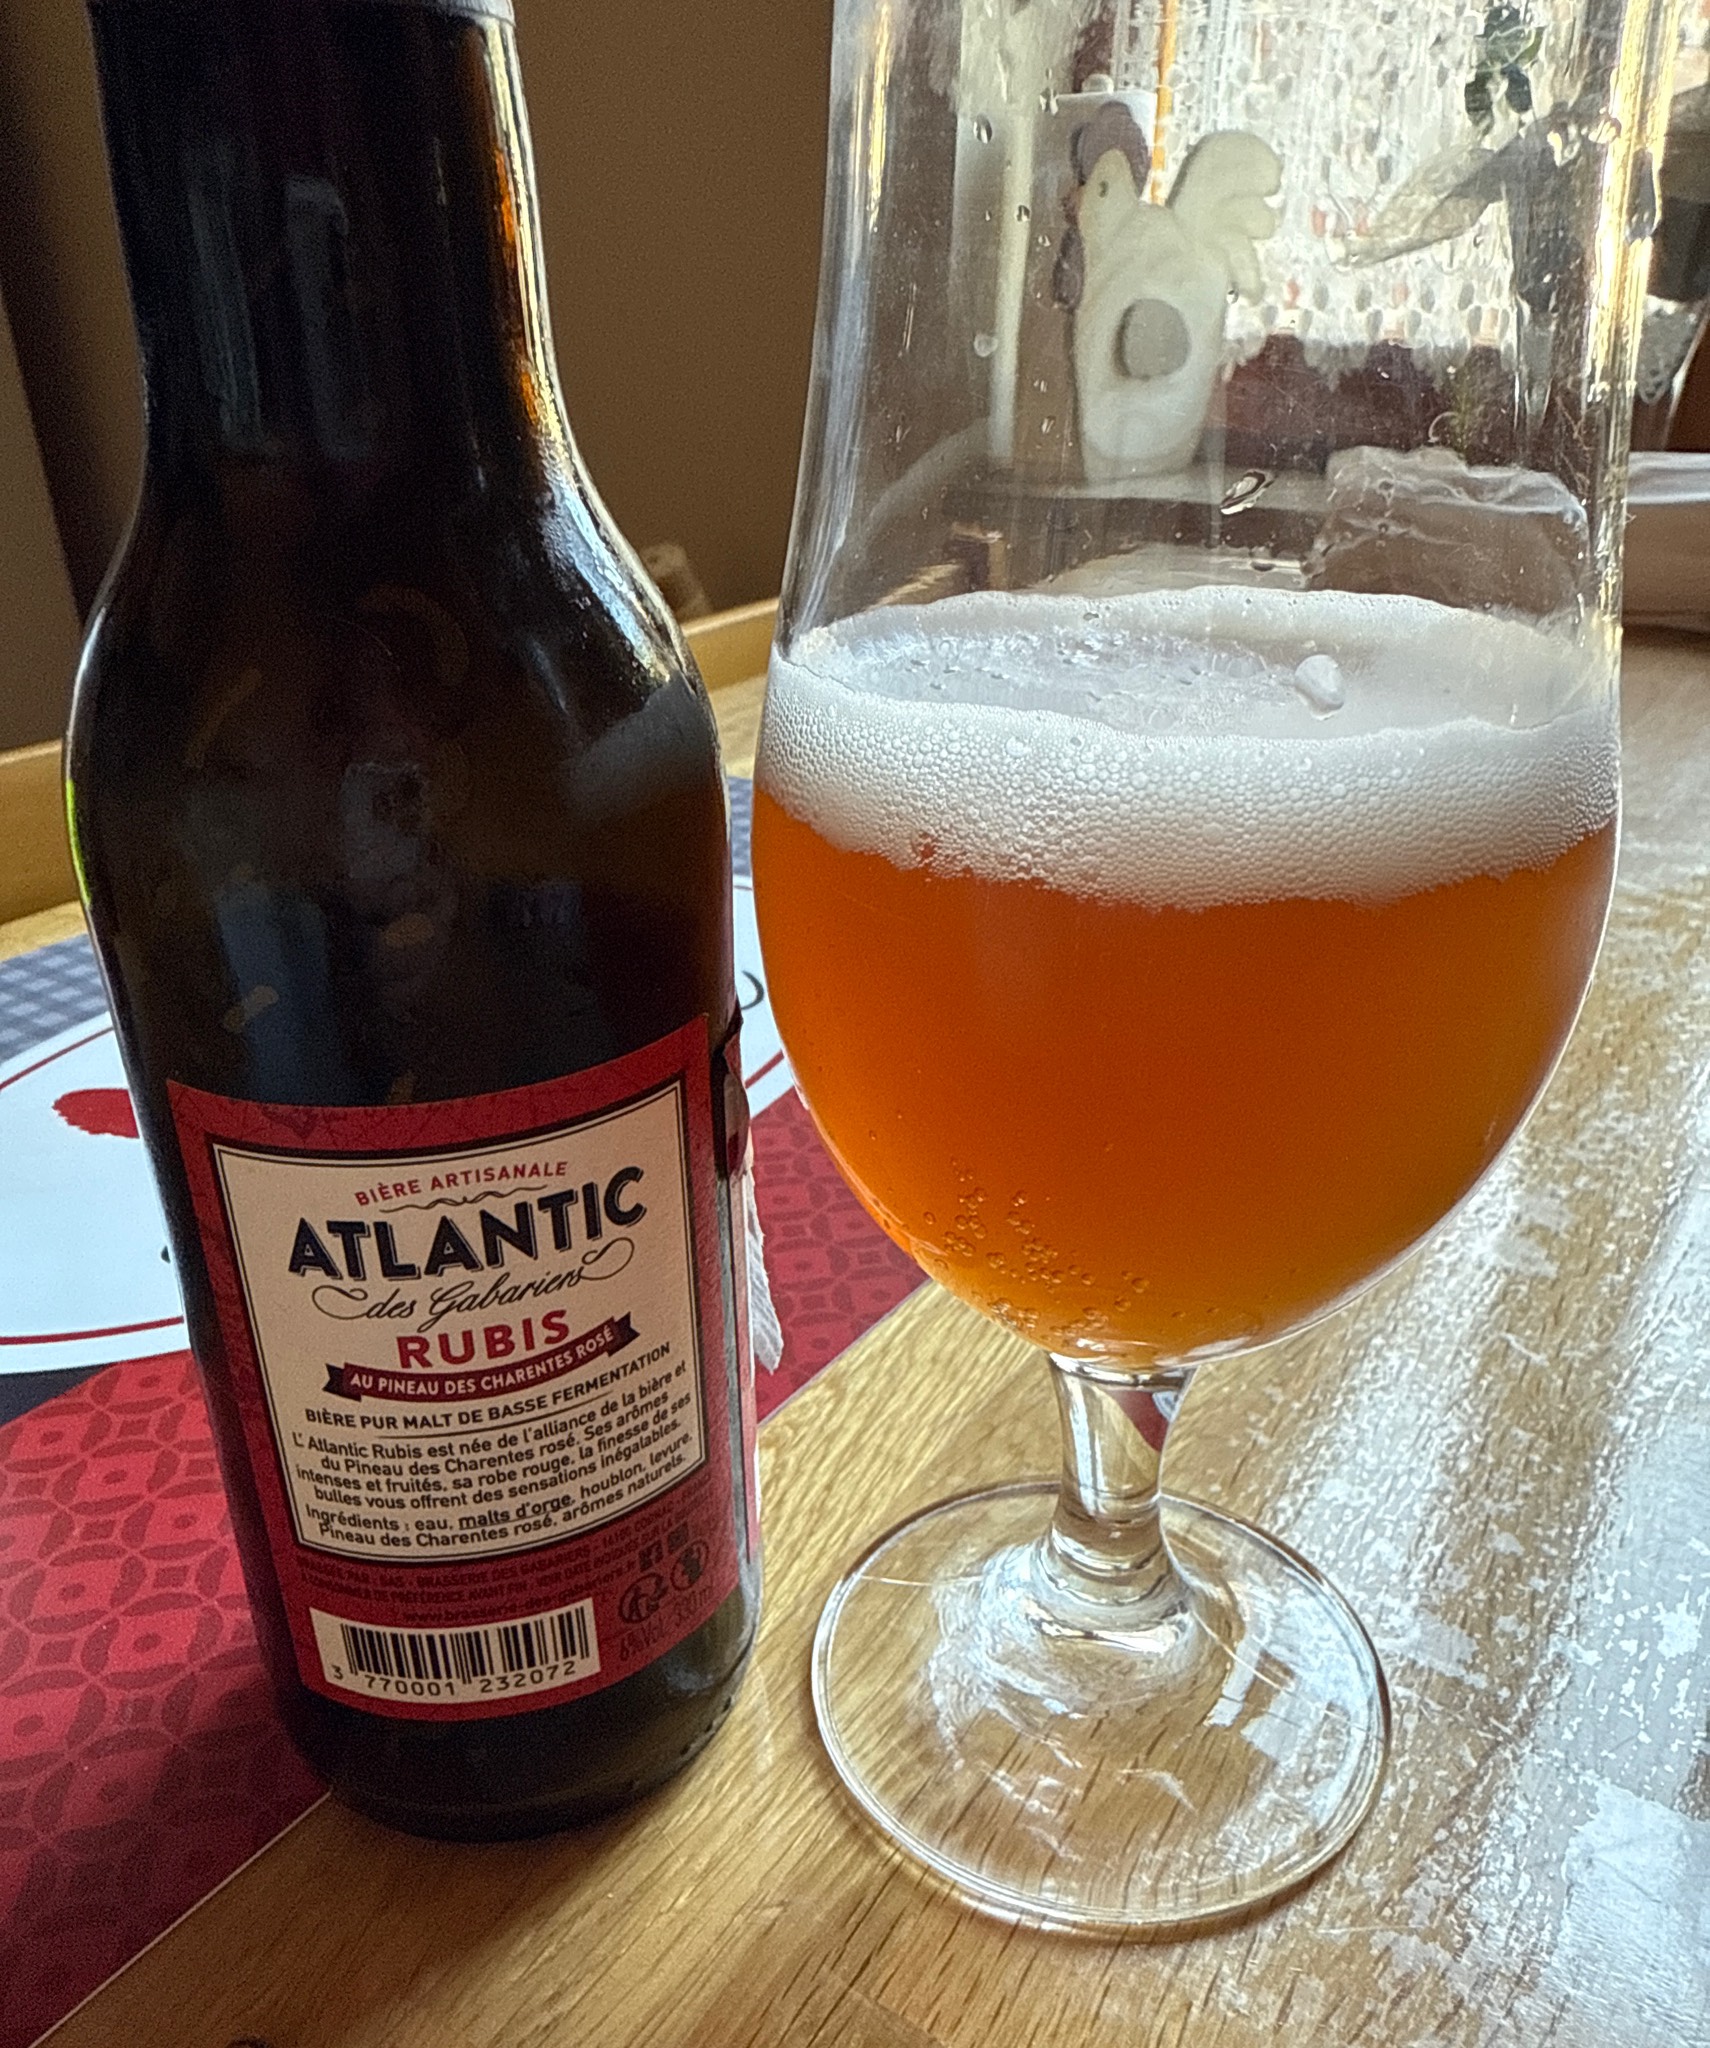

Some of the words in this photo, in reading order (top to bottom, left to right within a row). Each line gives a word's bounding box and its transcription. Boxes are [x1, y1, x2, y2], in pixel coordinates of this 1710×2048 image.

[287, 1165, 648, 1282] ATLANTIC
[355, 1181, 422, 1207] BIÈRE
[430, 1160, 569, 1191] ARTISANALE
[350, 1372, 374, 1389] AU
[378, 1376, 440, 1395] PINEAU
[445, 1377, 477, 1395] DES
[480, 1350, 574, 1391] CHARENTES
[575, 1324, 615, 1359] ROSÉ
[395, 1309, 571, 1369] RUBIS
[305, 1407, 357, 1428] BIÈRE
[360, 1414, 399, 1430] PUR
[402, 1412, 453, 1430] MALT
[457, 1409, 484, 1425] DE
[487, 1394, 549, 1421] BASSE
[551, 1340, 671, 1405] FERMENTATION
[372, 1443, 423, 1460] Rubis
[427, 1442, 455, 1458] est
[459, 1437, 492, 1455] née
[497, 1432, 519, 1449] de
[522, 1410, 597, 1443] l'alliance
[600, 1399, 619, 1417] de
[621, 1391, 636, 1407] la
[638, 1369, 673, 1400] bière
[674, 1359, 687, 1379] et
[296, 1463, 362, 1491] intenses
[366, 1478, 383, 1492] et
[452, 1477, 473, 1491] sa
[478, 1468, 518, 1487] robe
[578, 1446, 594, 1460] la
[597, 1418, 650, 1454] finesse
[652, 1408, 669, 1427] de
[670, 1391, 693, 1415] ses
[314, 1484, 362, 1506] bulles
[365, 1495, 407, 1509] vous
[410, 1491, 468, 1509] offrent
[472, 1488, 504, 1505] des
[507, 1460, 597, 1498] sensations
[600, 1417, 682, 1470] inégalables.
[320, 1455, 341, 1471] du
[344, 1458, 404, 1476] Pineau
[408, 1461, 441, 1475] des
[444, 1448, 535, 1473] Charentes
[539, 1432, 580, 1456] rosé.
[583, 1418, 613, 1441] Ses
[616, 1390, 669, 1428] arômes
[304, 1502, 400, 1532] Ingrédients
[457, 1508, 512, 1531] malts
[319, 1521, 376, 1546] Pineau
[379, 1529, 412, 1548] des
[415, 1526, 509, 1548] Charentes
[561, 1487, 625, 1522] arômes
[626, 1452, 687, 1495] naturels.
[330, 1663, 344, 1681] 3
[363, 1674, 456, 1697] 770001
[479, 1660, 577, 1694] 232072
